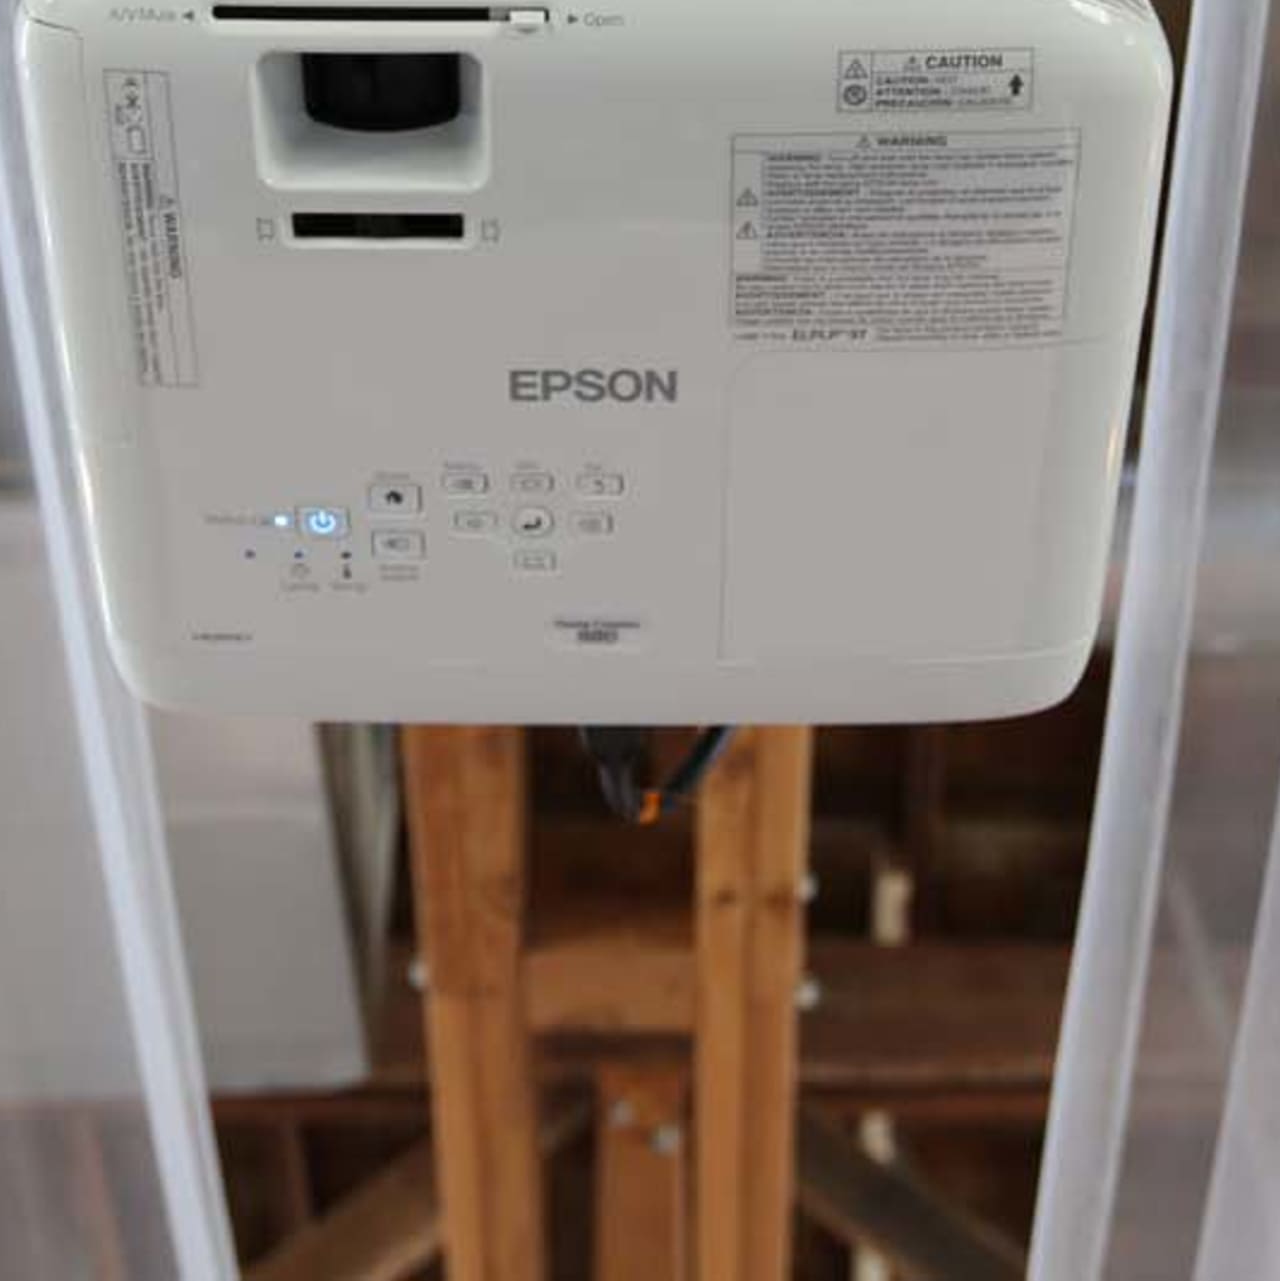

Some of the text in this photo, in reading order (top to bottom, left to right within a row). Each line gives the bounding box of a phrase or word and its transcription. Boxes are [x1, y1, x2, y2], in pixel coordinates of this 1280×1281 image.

[924, 53, 1004, 70] CAUTION
[876, 135, 948, 146] WARNING
[163, 211, 182, 279] WARNING
[509, 369, 678, 403] EPSON
